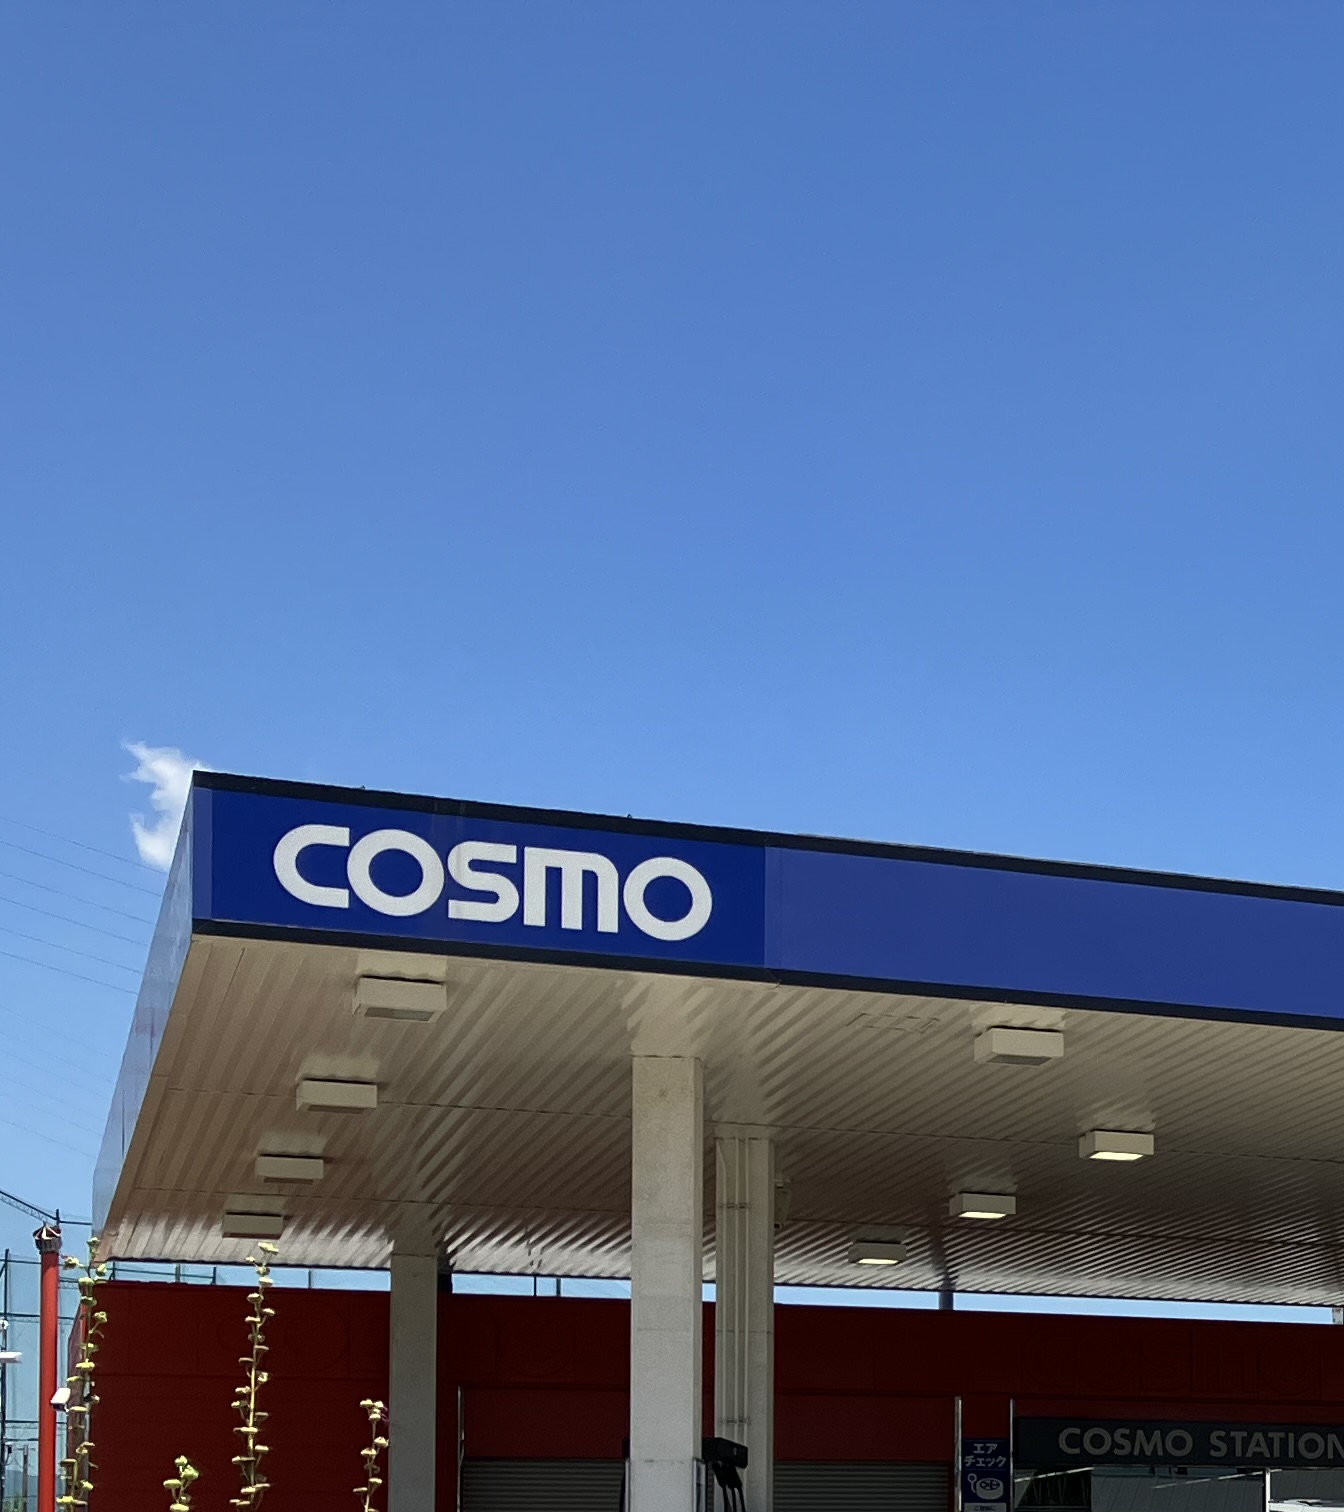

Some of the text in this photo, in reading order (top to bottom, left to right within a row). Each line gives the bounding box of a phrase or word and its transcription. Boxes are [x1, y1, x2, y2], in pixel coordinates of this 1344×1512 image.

[272, 823, 713, 942] COSMO
[972, 1442, 998, 1454] エア
[1058, 1426, 1193, 1458] COSMO
[963, 1455, 1007, 1468] チェック
